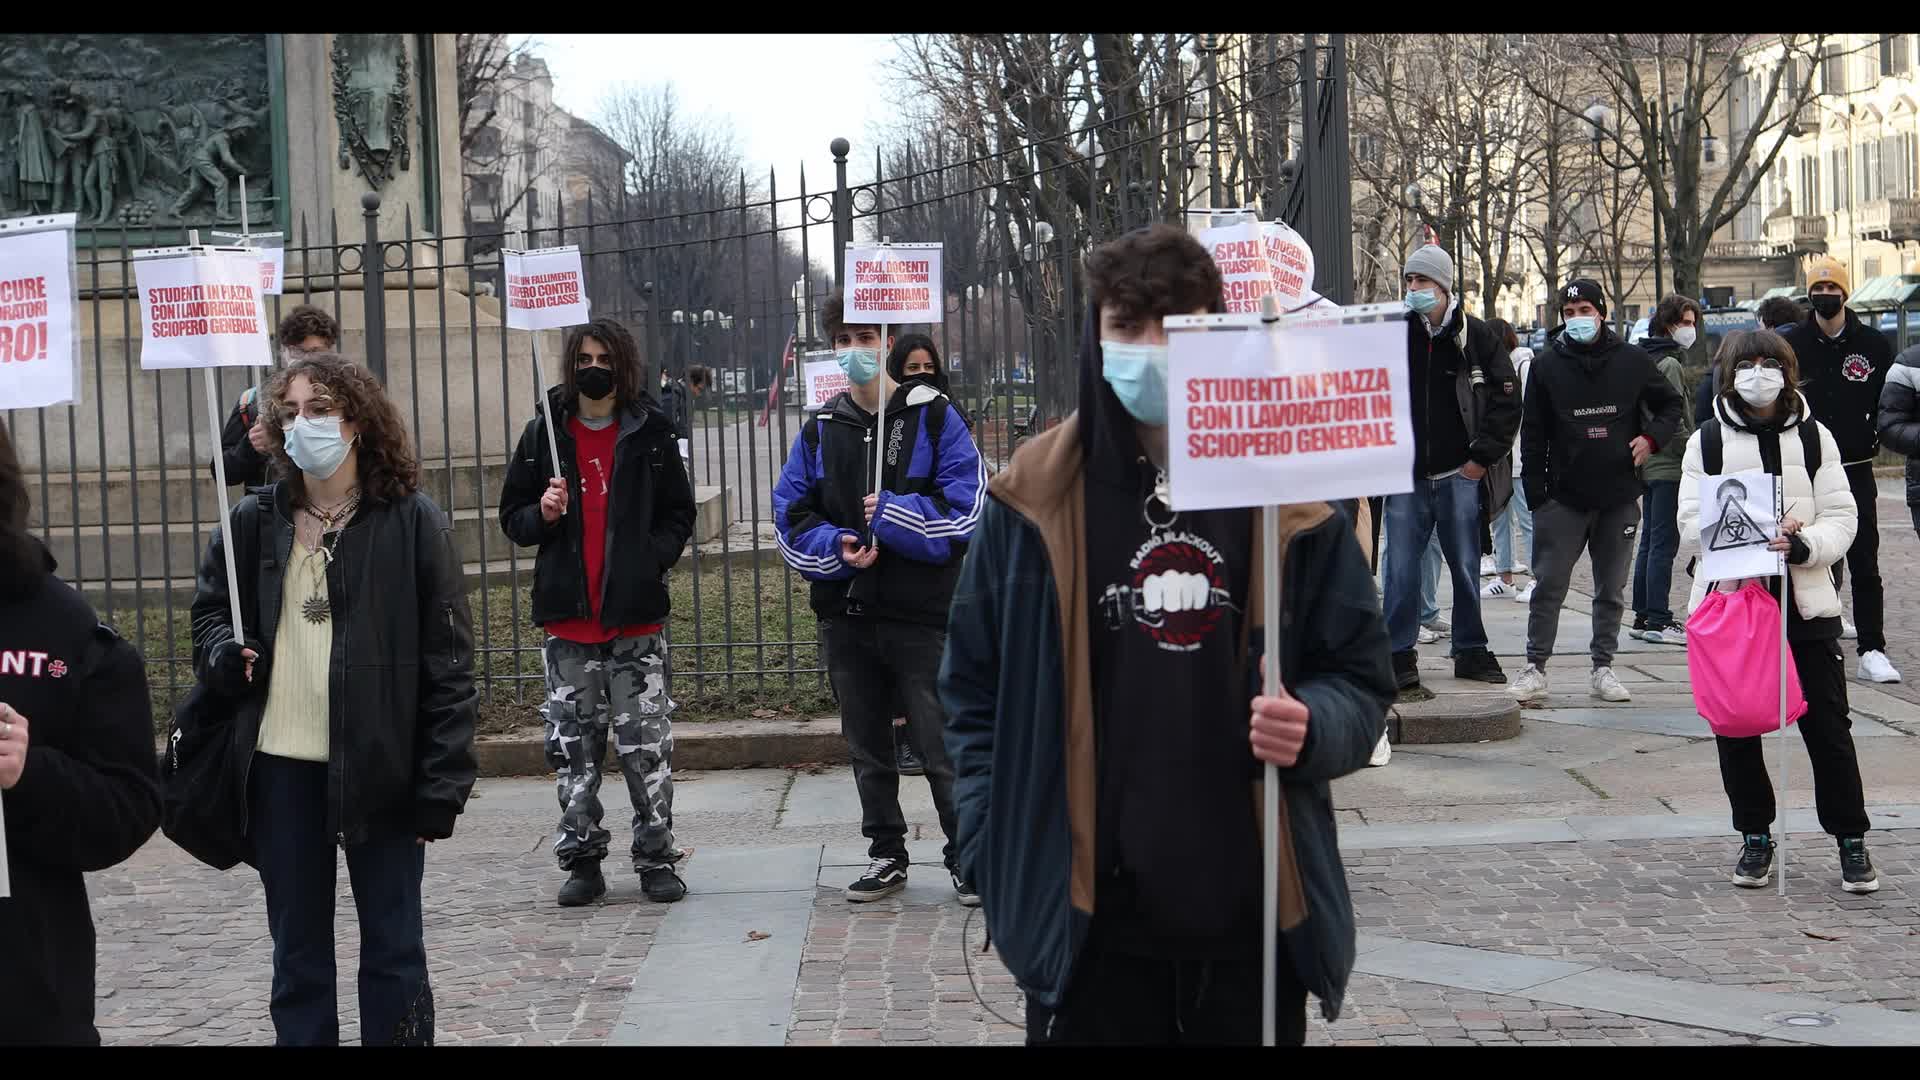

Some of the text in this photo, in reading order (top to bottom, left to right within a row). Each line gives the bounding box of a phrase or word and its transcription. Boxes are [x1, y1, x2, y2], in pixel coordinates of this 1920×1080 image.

[887, 261, 929, 273] DOCENTI
[531, 271, 577, 284] FALLIMENTO
[149, 285, 253, 304] STUDENTI IN PIAZZA
[538, 281, 578, 297] CONTRO
[854, 288, 930, 301] SCIOPERIAMO
[536, 296, 546, 308] DI
[547, 293, 580, 307] CLASSE
[854, 302, 868, 311] PER
[869, 301, 904, 311] STUDIARE
[151, 304, 175, 320] CON
[176, 303, 180, 319] I
[181, 301, 244, 318] LAVORATORI
[152, 318, 258, 338] SCIOPERO GENERALE
[1186, 367, 1391, 402] STUDENTI IN PIAZZA
[1187, 394, 1393, 430] CON I LAVORATORI IN
[887, 418, 904, 466] adidas
[1187, 422, 1397, 459] SCIOPERO GENERALE
